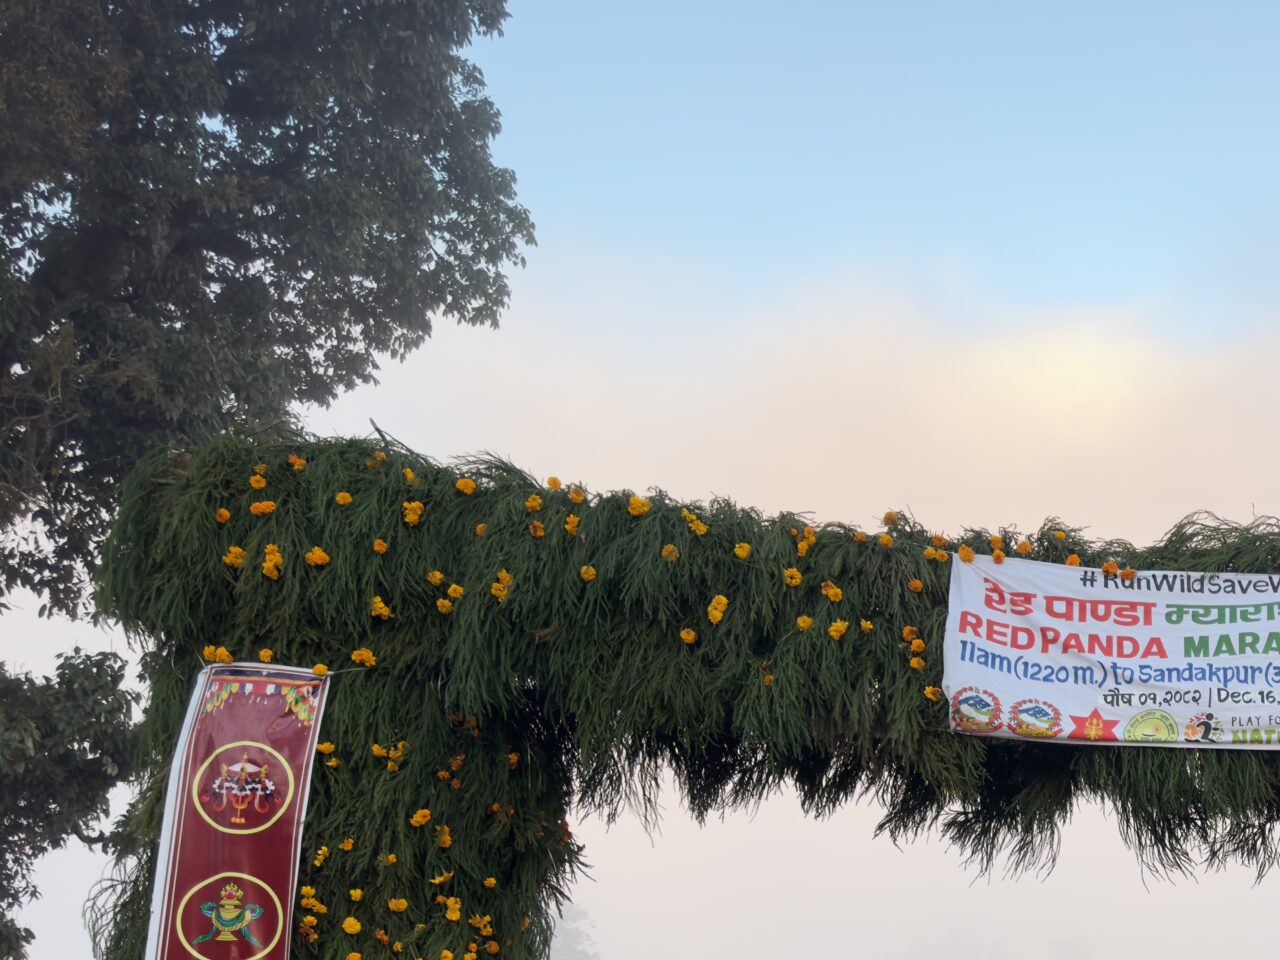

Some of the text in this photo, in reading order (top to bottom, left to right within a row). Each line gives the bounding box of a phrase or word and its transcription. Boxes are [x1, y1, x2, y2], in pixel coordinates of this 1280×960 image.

[983, 577, 1037, 616] रेड
[1043, 595, 1157, 626] पाण्डा
[958, 610, 1036, 650] RED
[1039, 626, 1168, 659] PANDA
[1110, 661, 1135, 686] to
[1102, 687, 1135, 707] पौष
[1231, 715, 1262, 727] PLAY
